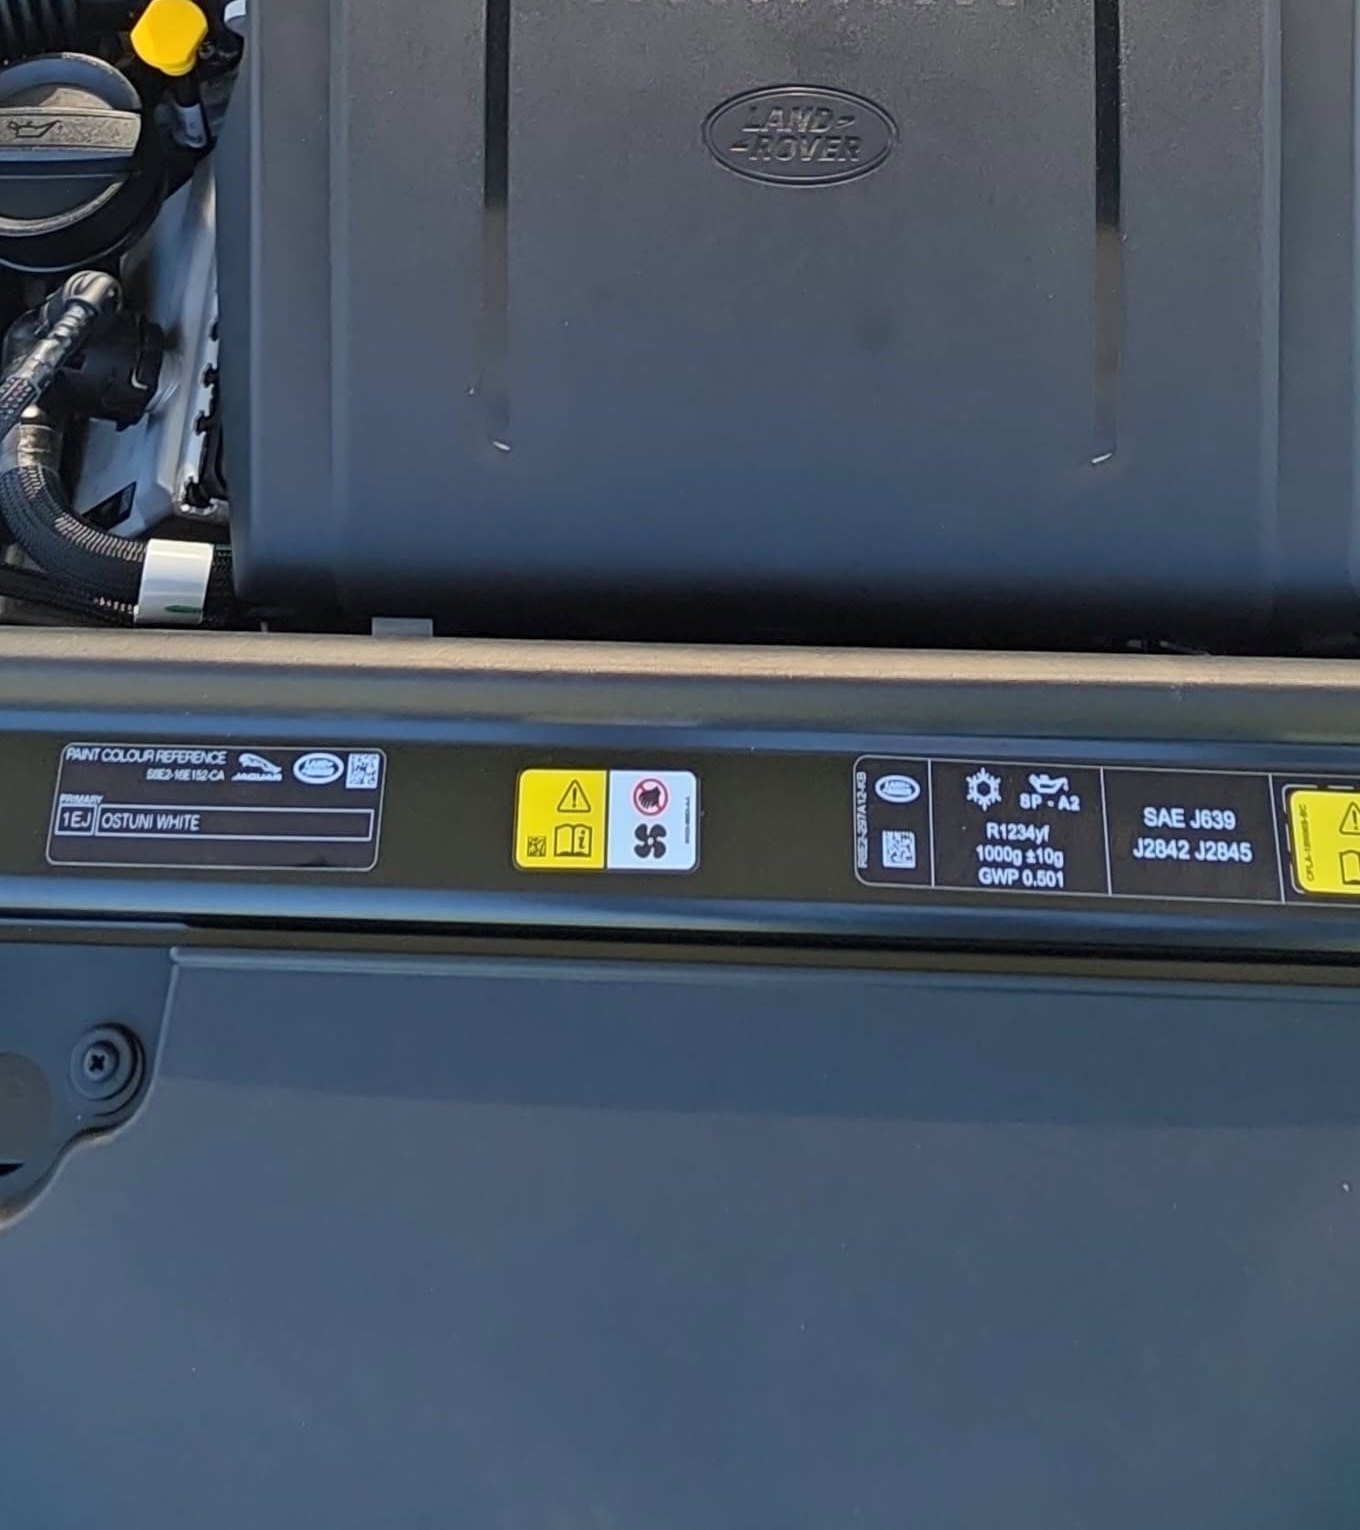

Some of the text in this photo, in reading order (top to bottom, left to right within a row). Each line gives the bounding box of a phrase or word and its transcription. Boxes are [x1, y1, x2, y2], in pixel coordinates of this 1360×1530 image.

[742, 106, 835, 133] LAND
[748, 135, 861, 162] ROVER
[65, 747, 227, 765] PAINT COLOUR REFERENCE
[59, 793, 103, 804] PRIMARY
[1019, 793, 1041, 809] SP
[1058, 795, 1081, 811] A2
[63, 811, 91, 827] 1EJ
[101, 812, 200, 831] OSTUNI WHITE
[1143, 806, 1236, 830] SAE J639
[986, 822, 1050, 844] R1234yf
[976, 845, 1064, 869] 1000g ±10g
[1133, 838, 1252, 862] J2842 J2845
[978, 867, 1064, 888] GWP 0.501
